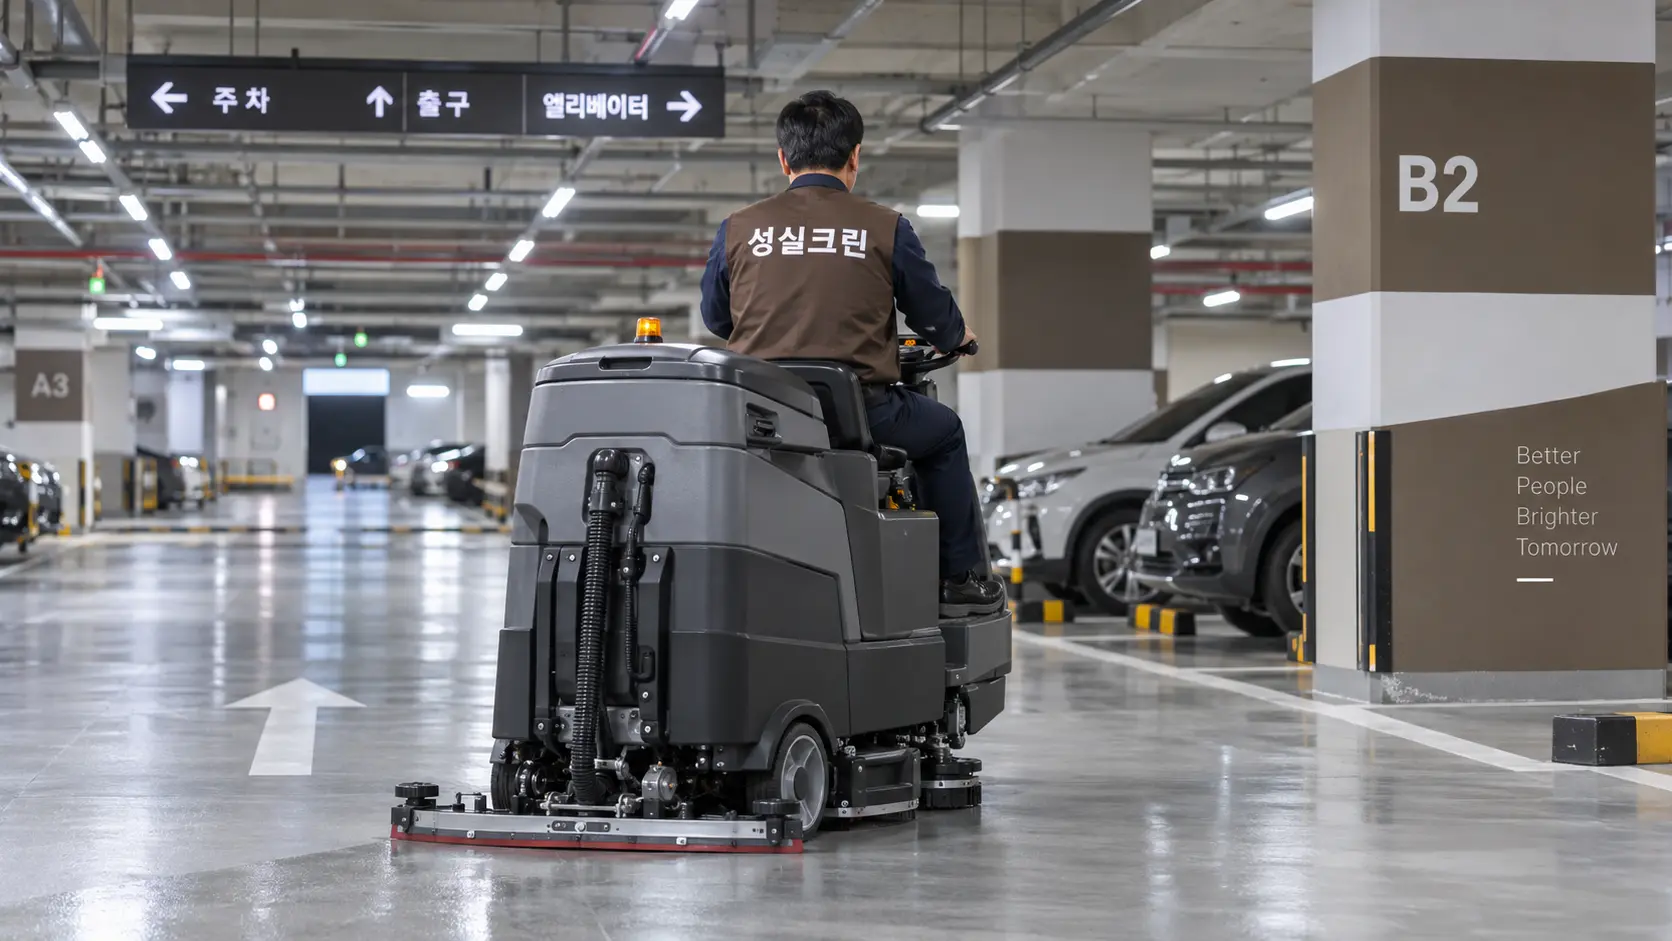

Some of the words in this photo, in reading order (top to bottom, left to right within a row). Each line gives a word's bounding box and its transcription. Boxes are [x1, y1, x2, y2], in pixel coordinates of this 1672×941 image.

[417, 90, 470, 117] 출구
[1399, 155, 1479, 213] B2
[747, 226, 867, 259] 성실크린
[31, 372, 69, 399] A3
[1517, 446, 1581, 464] Better
[1517, 476, 1587, 499] People
[1517, 506, 1598, 529] Brighter
[1516, 538, 1618, 556] Tomorrow
